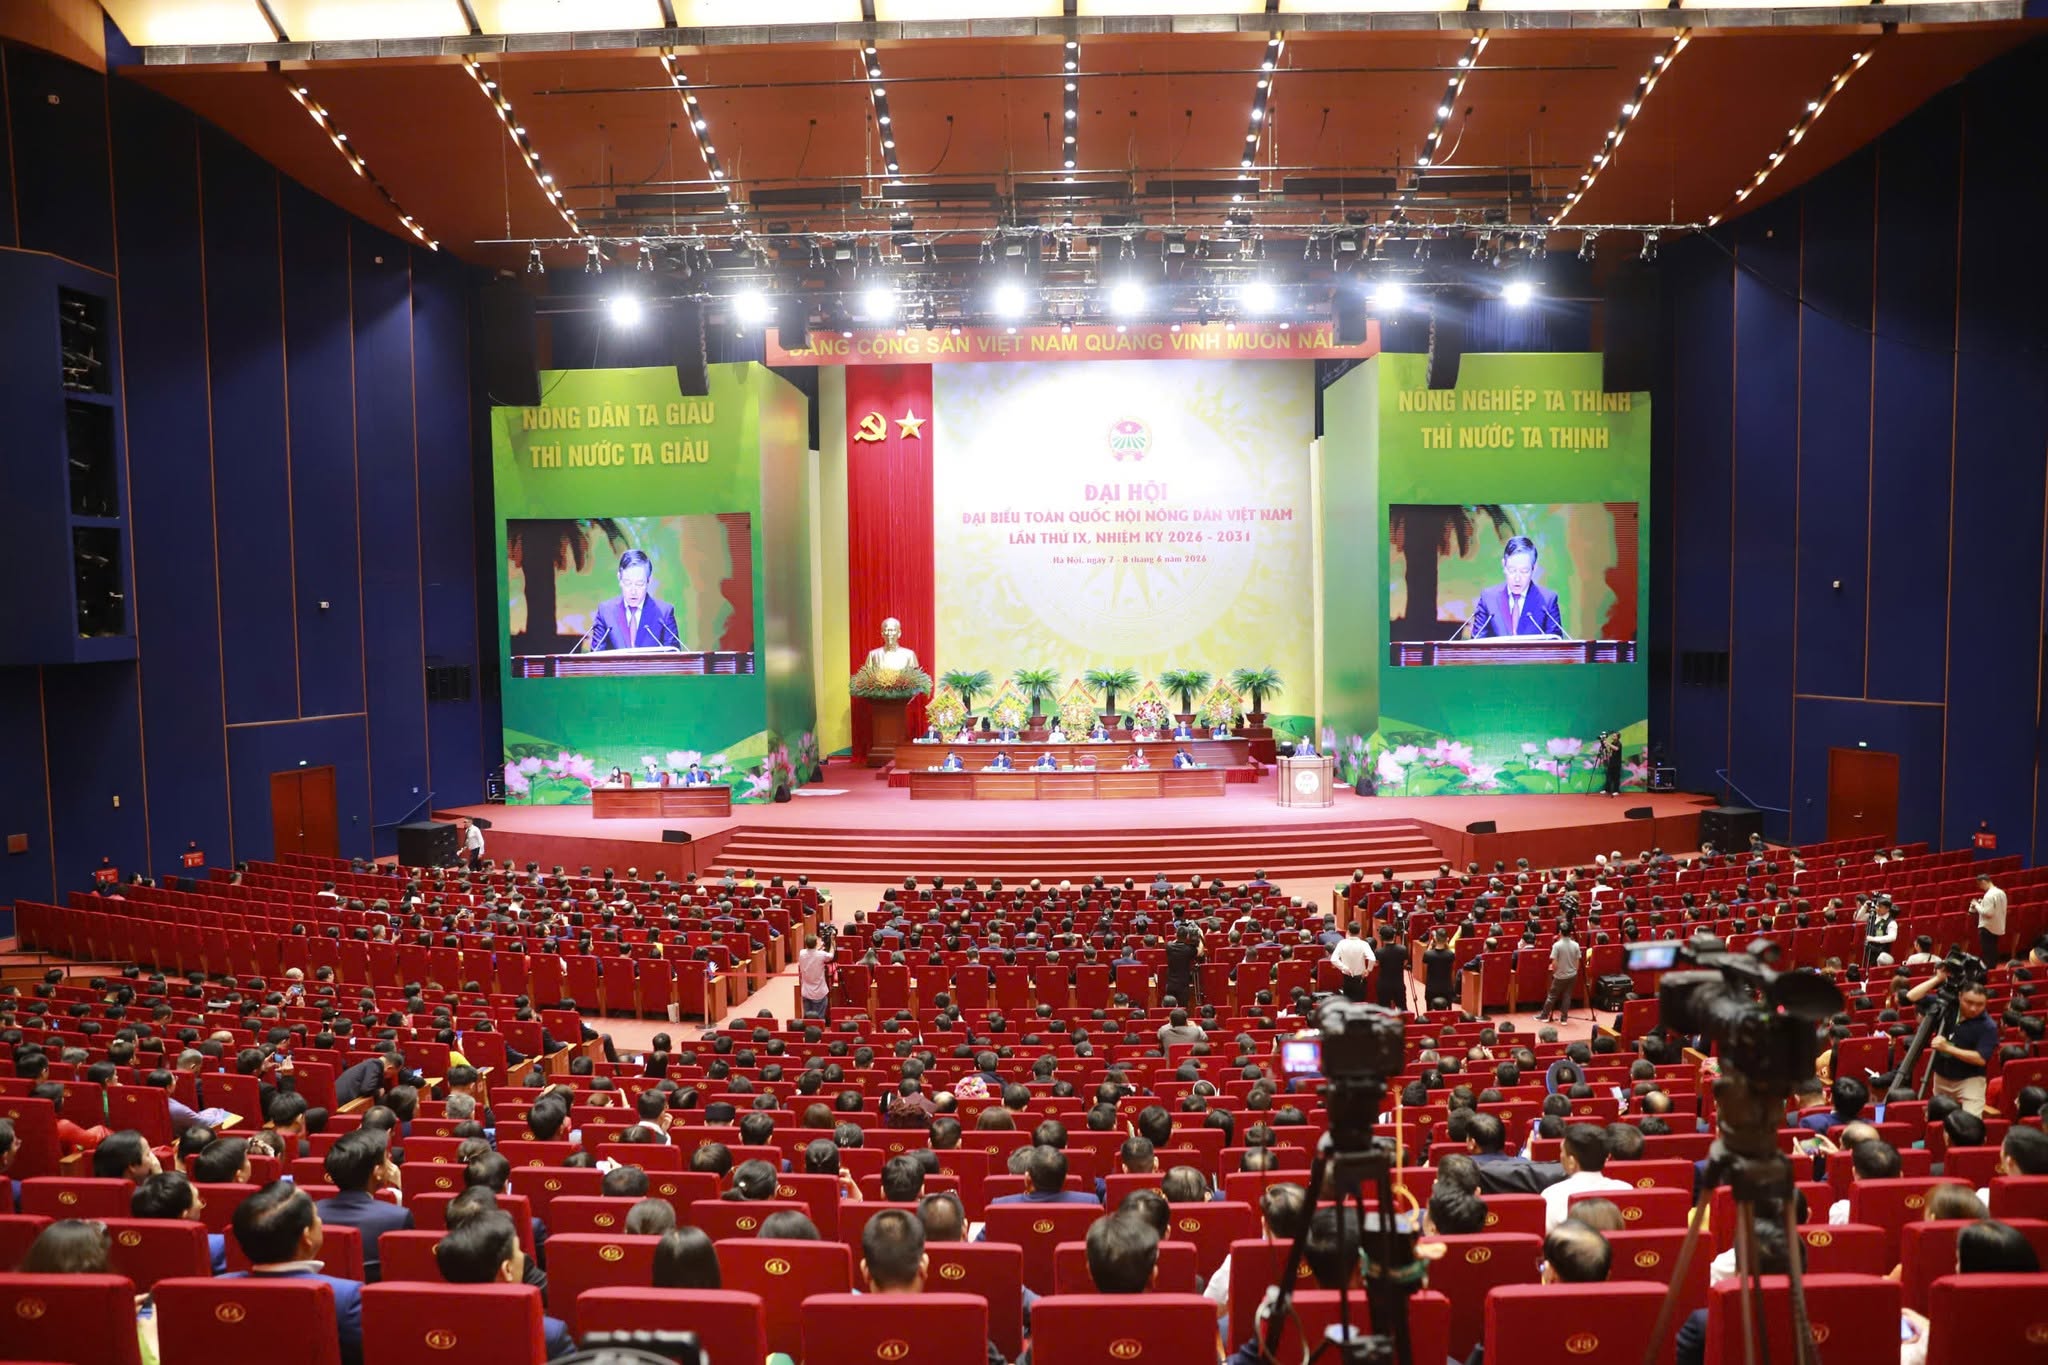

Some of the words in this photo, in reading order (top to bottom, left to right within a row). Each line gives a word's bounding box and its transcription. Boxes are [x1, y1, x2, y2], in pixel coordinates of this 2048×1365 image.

[857, 334, 920, 359] CỘNG
[927, 331, 970, 354] SẢN
[977, 331, 1024, 357] VIỆT
[1031, 334, 1078, 352] NAM
[1085, 333, 1163, 353] QUANG
[1169, 332, 1220, 350] VINH
[1227, 328, 1291, 350] MUÔN
[523, 404, 581, 430] NÔNG
[588, 401, 630, 428] DÂN
[636, 404, 660, 426] TA
[666, 398, 715, 426] GIÀU
[1399, 386, 1456, 412] NÔNG
[1462, 386, 1536, 415] NGHIỆP
[1544, 390, 1566, 412] TA
[1571, 390, 1631, 416] THỊNH
[530, 441, 562, 468] THÌ
[568, 439, 625, 467] NƯỚC
[631, 442, 654, 465] TA
[660, 437, 709, 464] GIÀU
[1421, 424, 1453, 449] THÌ
[1459, 422, 1514, 449] NƯỚC
[1521, 427, 1543, 449] TA
[1549, 427, 1609, 453] THỊNH
[1084, 483, 1121, 505] ĐẠI
[1128, 480, 1168, 505] HỘI
[962, 512, 986, 527] ĐẠI
[990, 507, 1020, 524] BIỂU
[1024, 508, 1064, 523] TOÀN
[1069, 507, 1111, 524] QUỐC
[1115, 508, 1141, 524] HỘI
[1145, 507, 1188, 522] NÔNG
[1193, 507, 1222, 521] DÂN
[1227, 507, 1256, 523] VIỆT
[1260, 508, 1292, 521] NAM
[1040, 530, 1070, 544] THỨ
[1073, 532, 1091, 545] IX,
[1096, 531, 1141, 546] NHIỆM
[1168, 531, 1203, 543] 2026
[1217, 531, 1250, 542] 2031
[1109, 555, 1114, 564] 7
[1123, 555, 1128, 563] 8
[1156, 555, 1162, 563] 6
[1184, 554, 1207, 563] 2026
